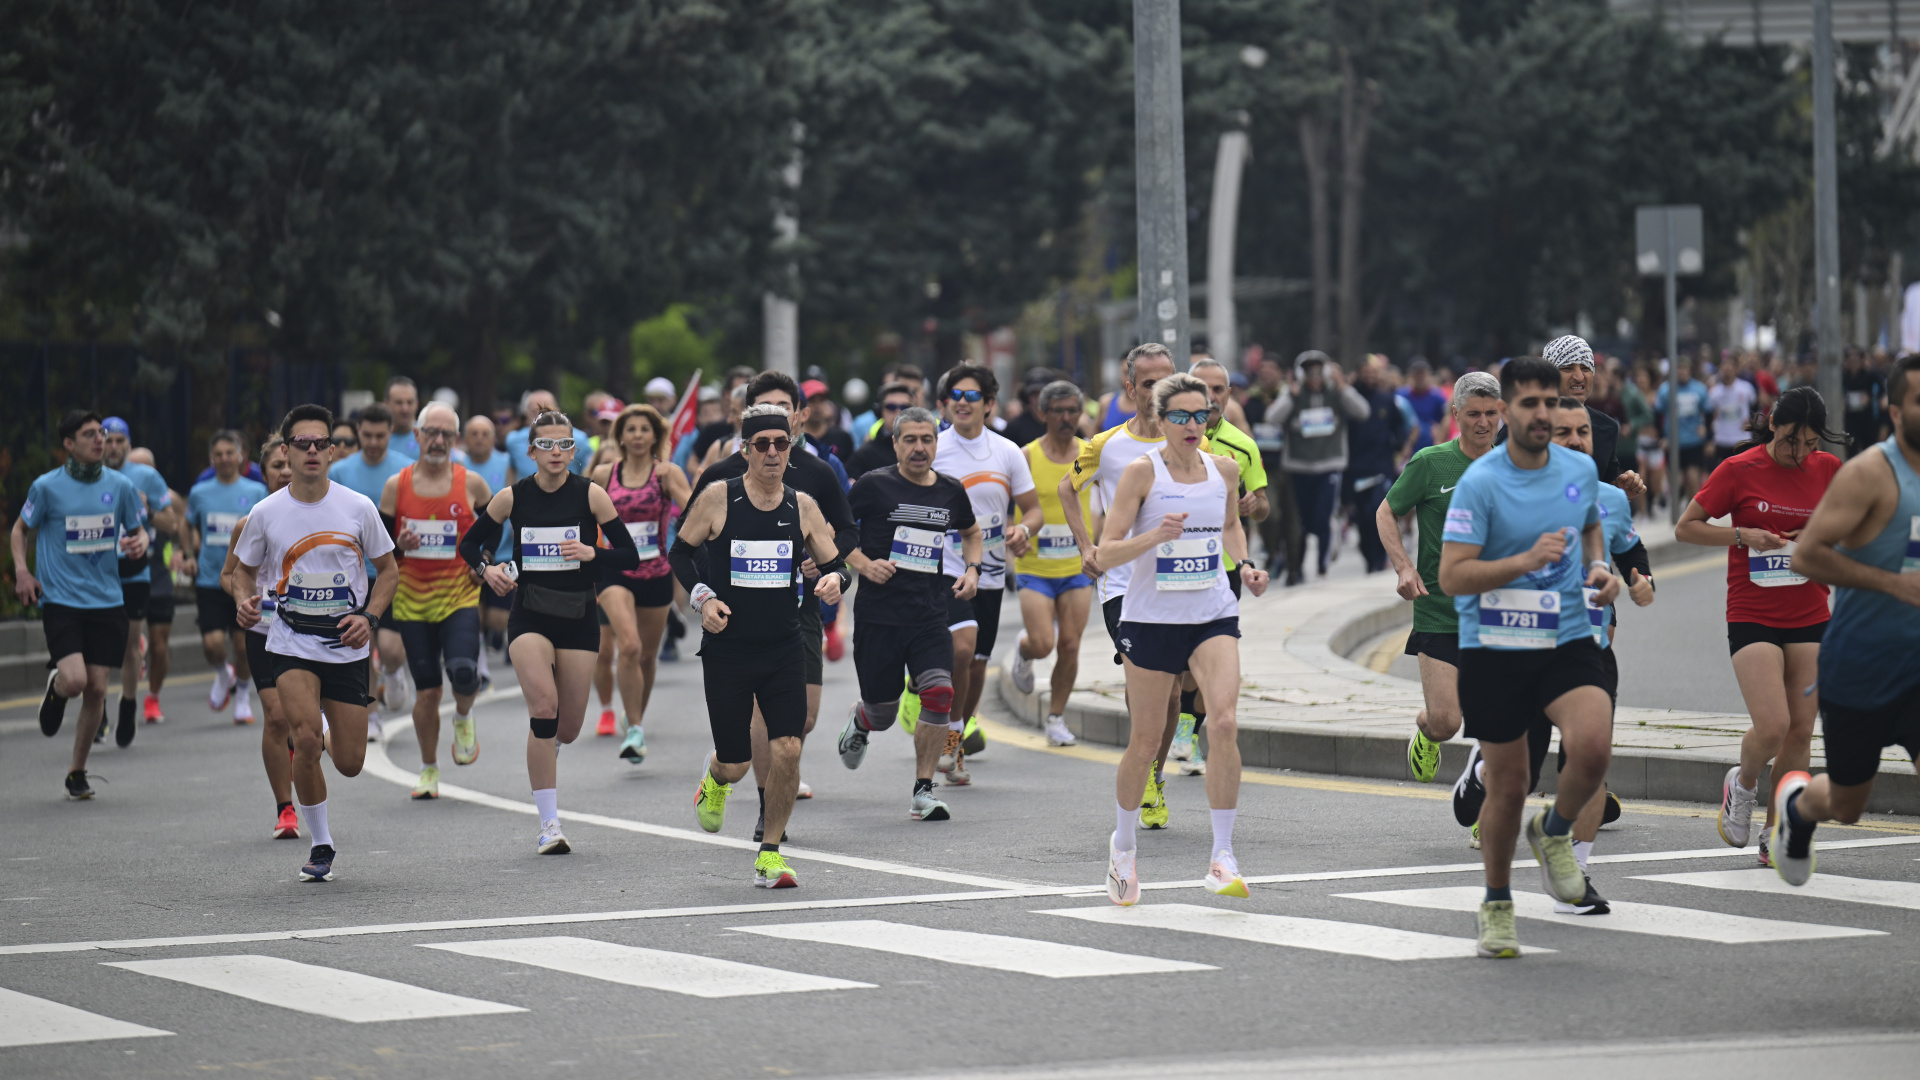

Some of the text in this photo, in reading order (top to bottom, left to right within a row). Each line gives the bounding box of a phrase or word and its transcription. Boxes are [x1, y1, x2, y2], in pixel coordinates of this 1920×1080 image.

[420, 534, 444, 545] 459
[906, 544, 932, 558] 1355
[746, 560, 778, 572] 1255
[1173, 558, 1209, 572] 2031
[1766, 556, 1791, 569] 175
[302, 588, 334, 601] 1799
[1500, 611, 1538, 628] 1781
